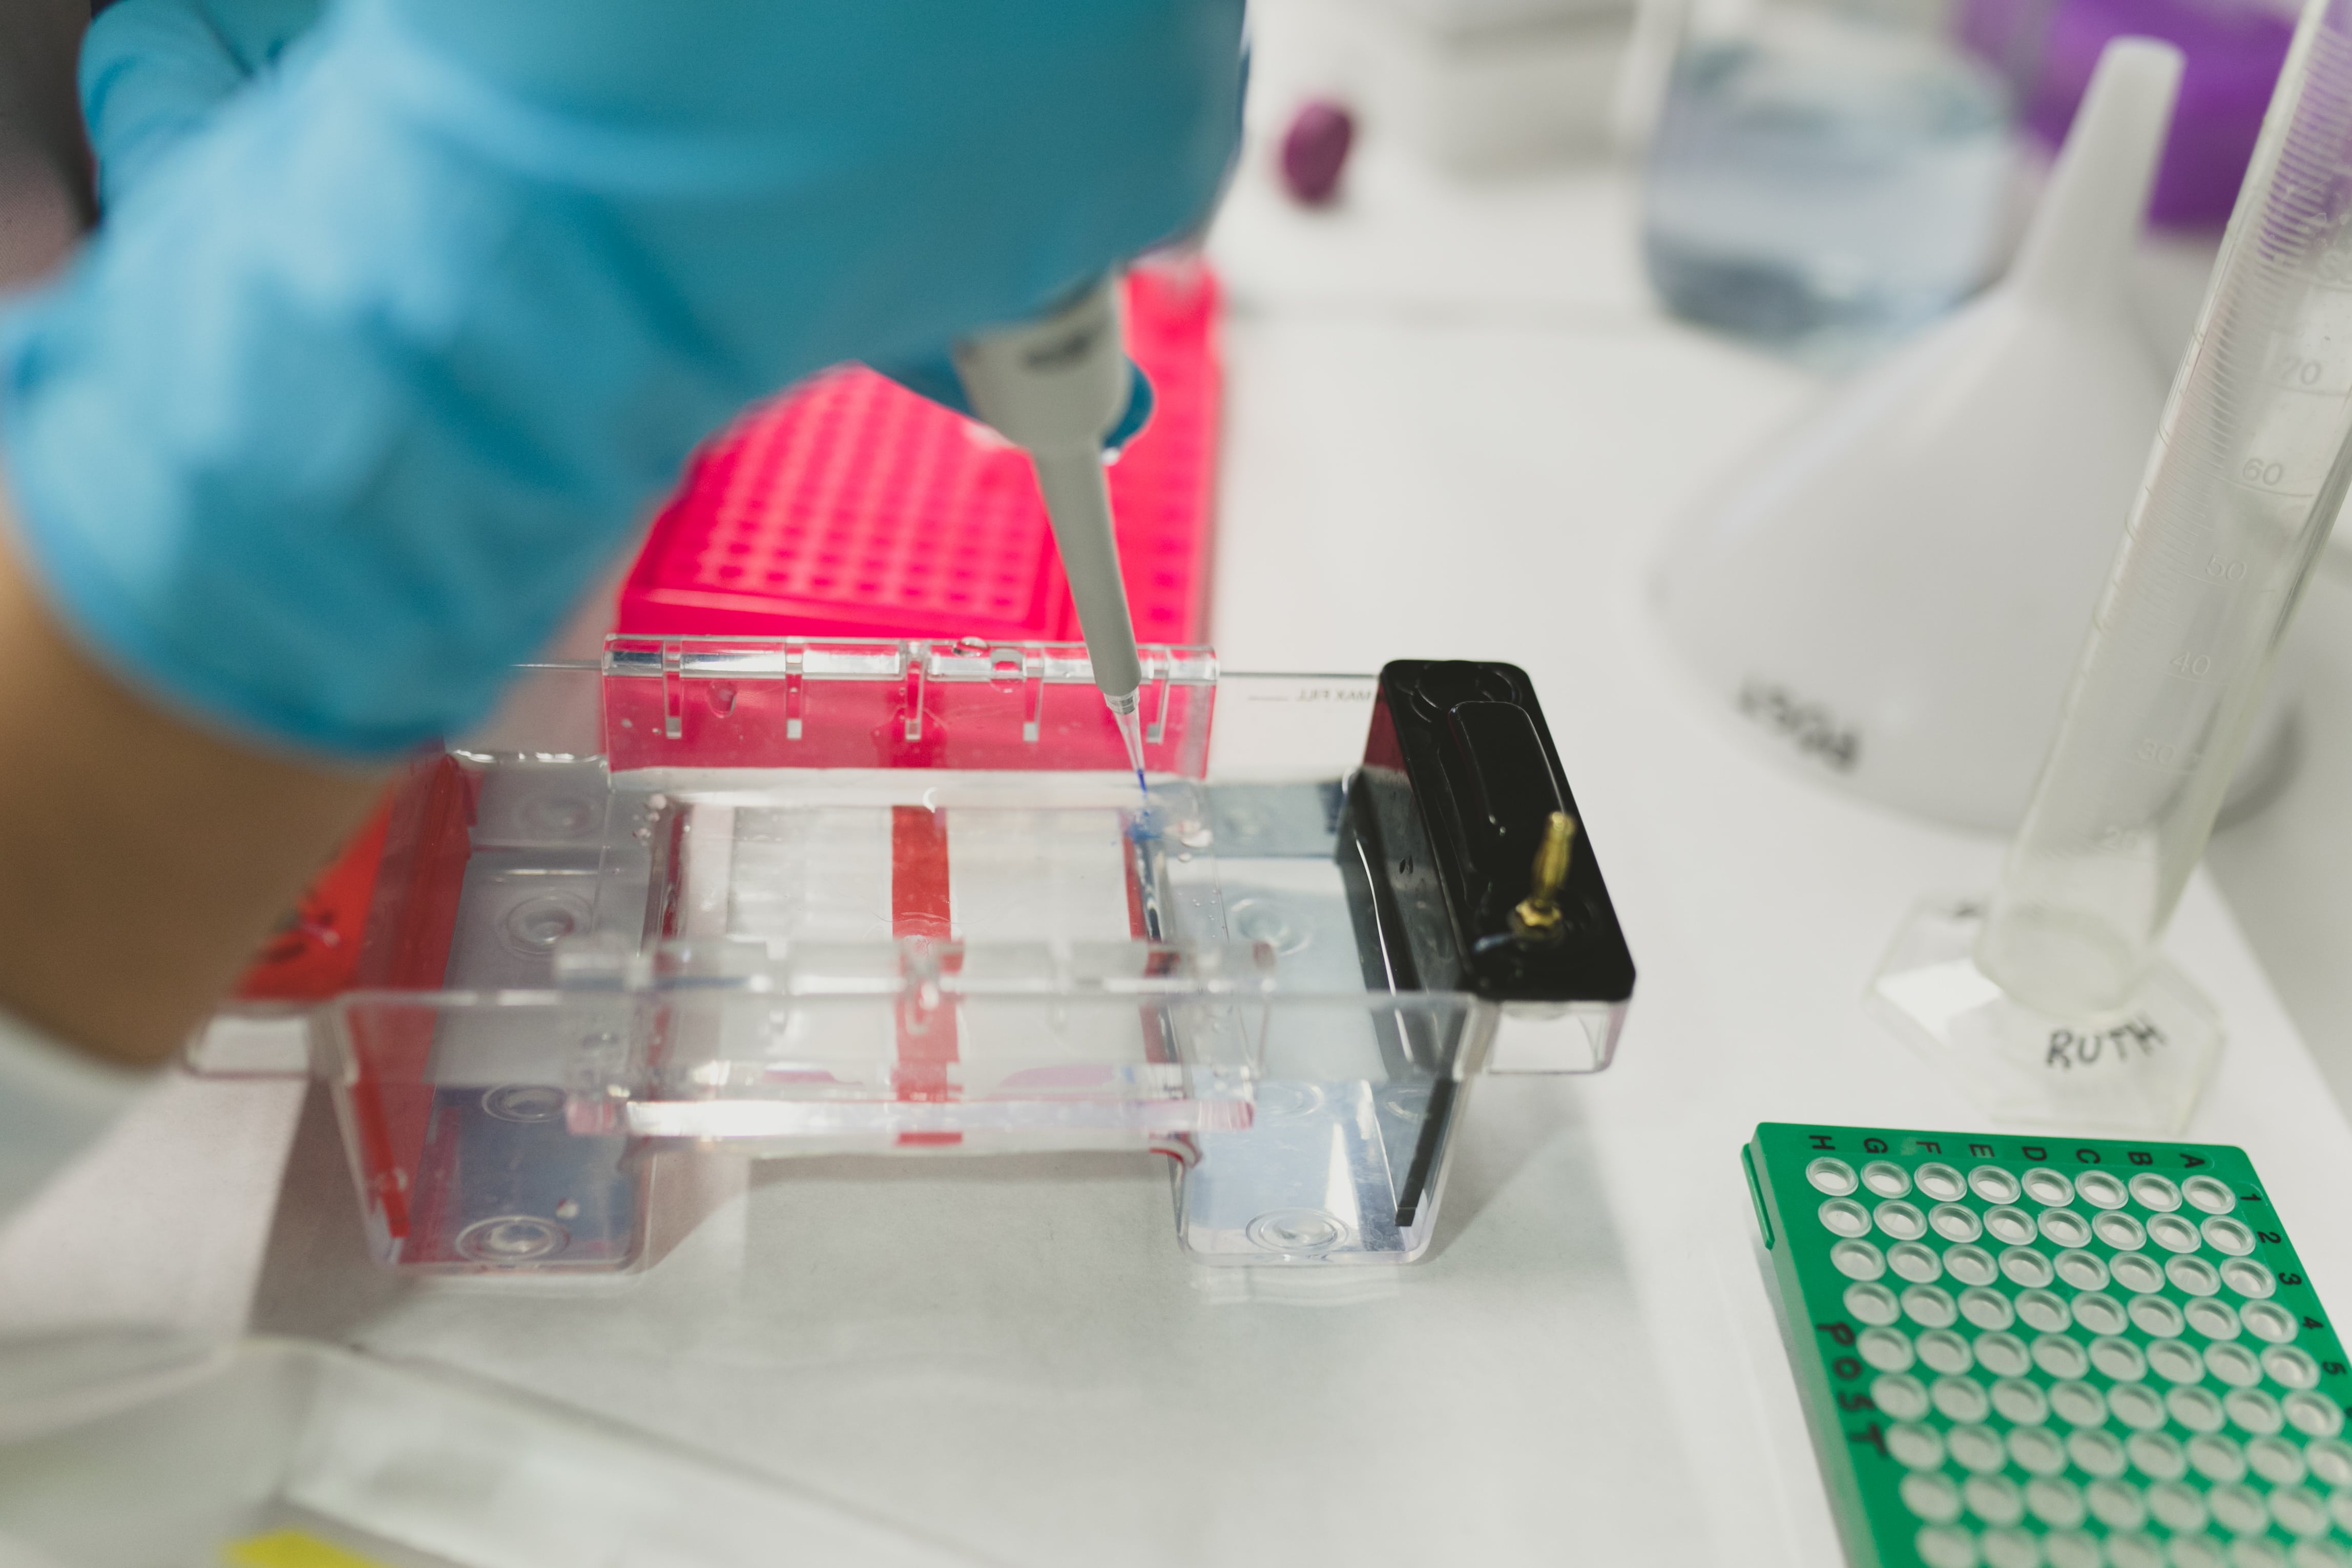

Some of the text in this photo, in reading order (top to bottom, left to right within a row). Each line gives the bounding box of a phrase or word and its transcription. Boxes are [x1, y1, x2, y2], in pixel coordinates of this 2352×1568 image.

[2242, 457, 2284, 487] 60
[2204, 553, 2247, 582] 50
[2170, 651, 2211, 676] 40
[2046, 1009, 2169, 1073] RUTH
[1808, 1135, 2207, 1168] H G F E D C B A
[2257, 1230, 2282, 1244] 2
[2278, 1272, 2302, 1286] 3
[2302, 1315, 2325, 1329] 4
[2322, 1360, 2347, 1376] 5
